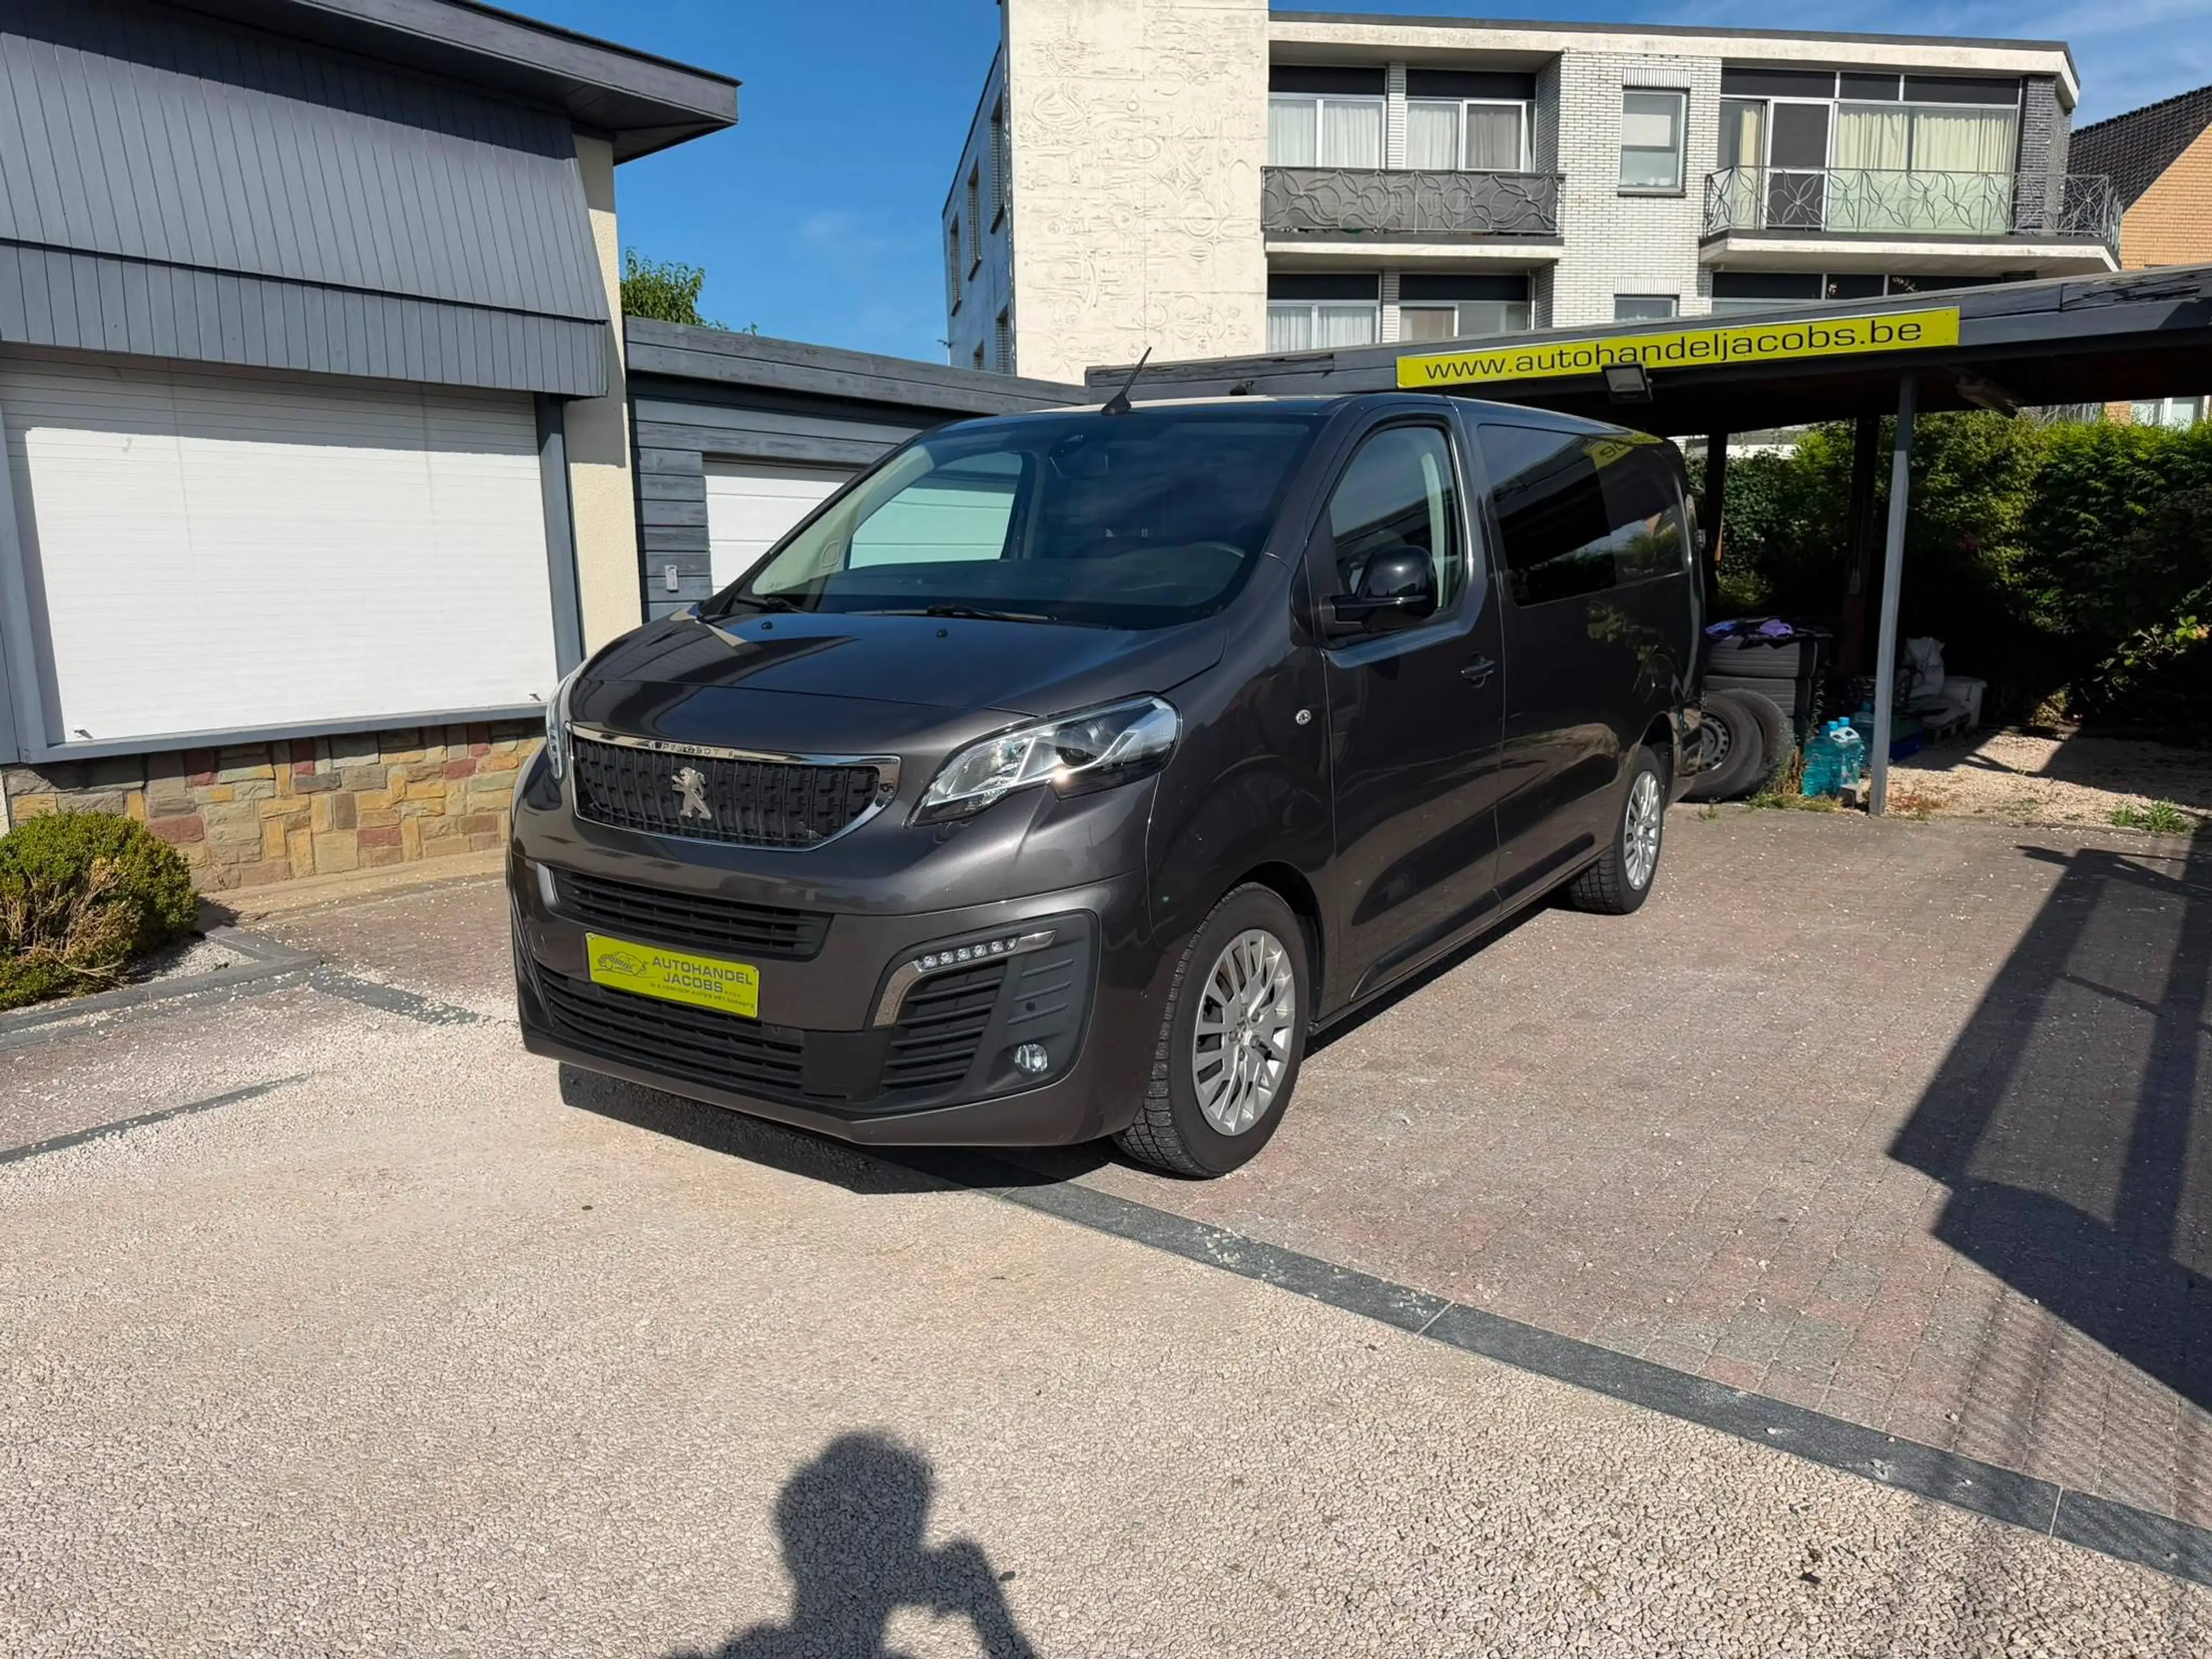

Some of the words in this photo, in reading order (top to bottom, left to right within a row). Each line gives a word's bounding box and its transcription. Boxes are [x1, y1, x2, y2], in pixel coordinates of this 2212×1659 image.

[1425, 318, 1922, 380] www.autohandeljacobs.be
[652, 956, 753, 986] AUTOHANDEL
[663, 973, 724, 993] JACOBS
